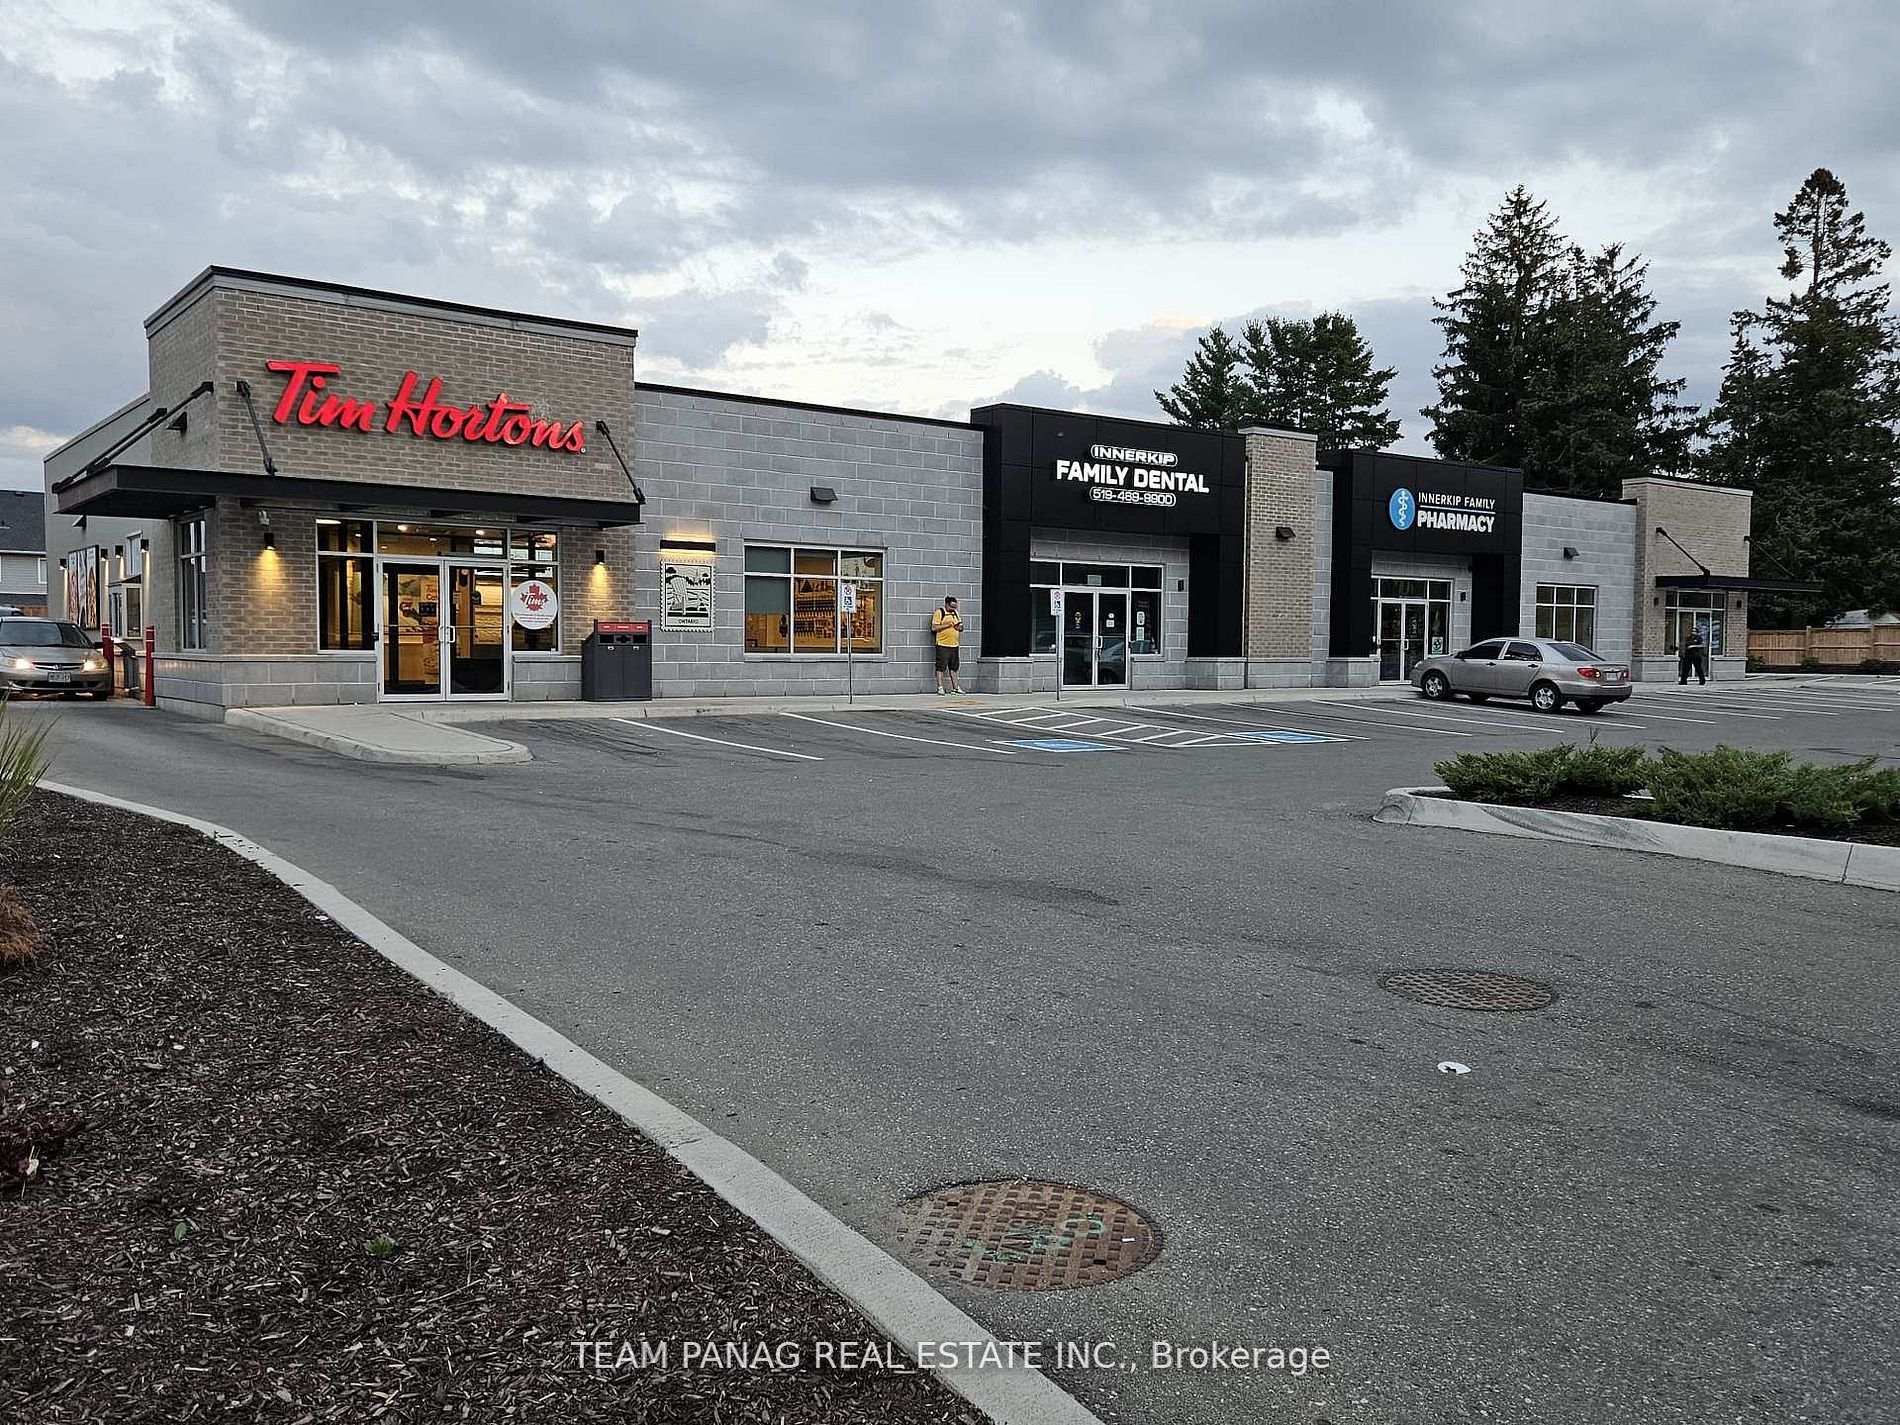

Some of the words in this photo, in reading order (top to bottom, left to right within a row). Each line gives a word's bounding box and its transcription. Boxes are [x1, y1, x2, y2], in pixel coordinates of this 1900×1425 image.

[265, 359, 376, 433] Tim
[384, 369, 586, 454] Hortons
[1094, 446, 1175, 465] INNERKIP
[1056, 459, 1129, 486] FAMILY
[1133, 468, 1210, 493] DENTAL
[1418, 491, 1462, 507] INNERKIP
[1464, 496, 1496, 510] FAMILY
[1417, 510, 1495, 533] PHARMACY
